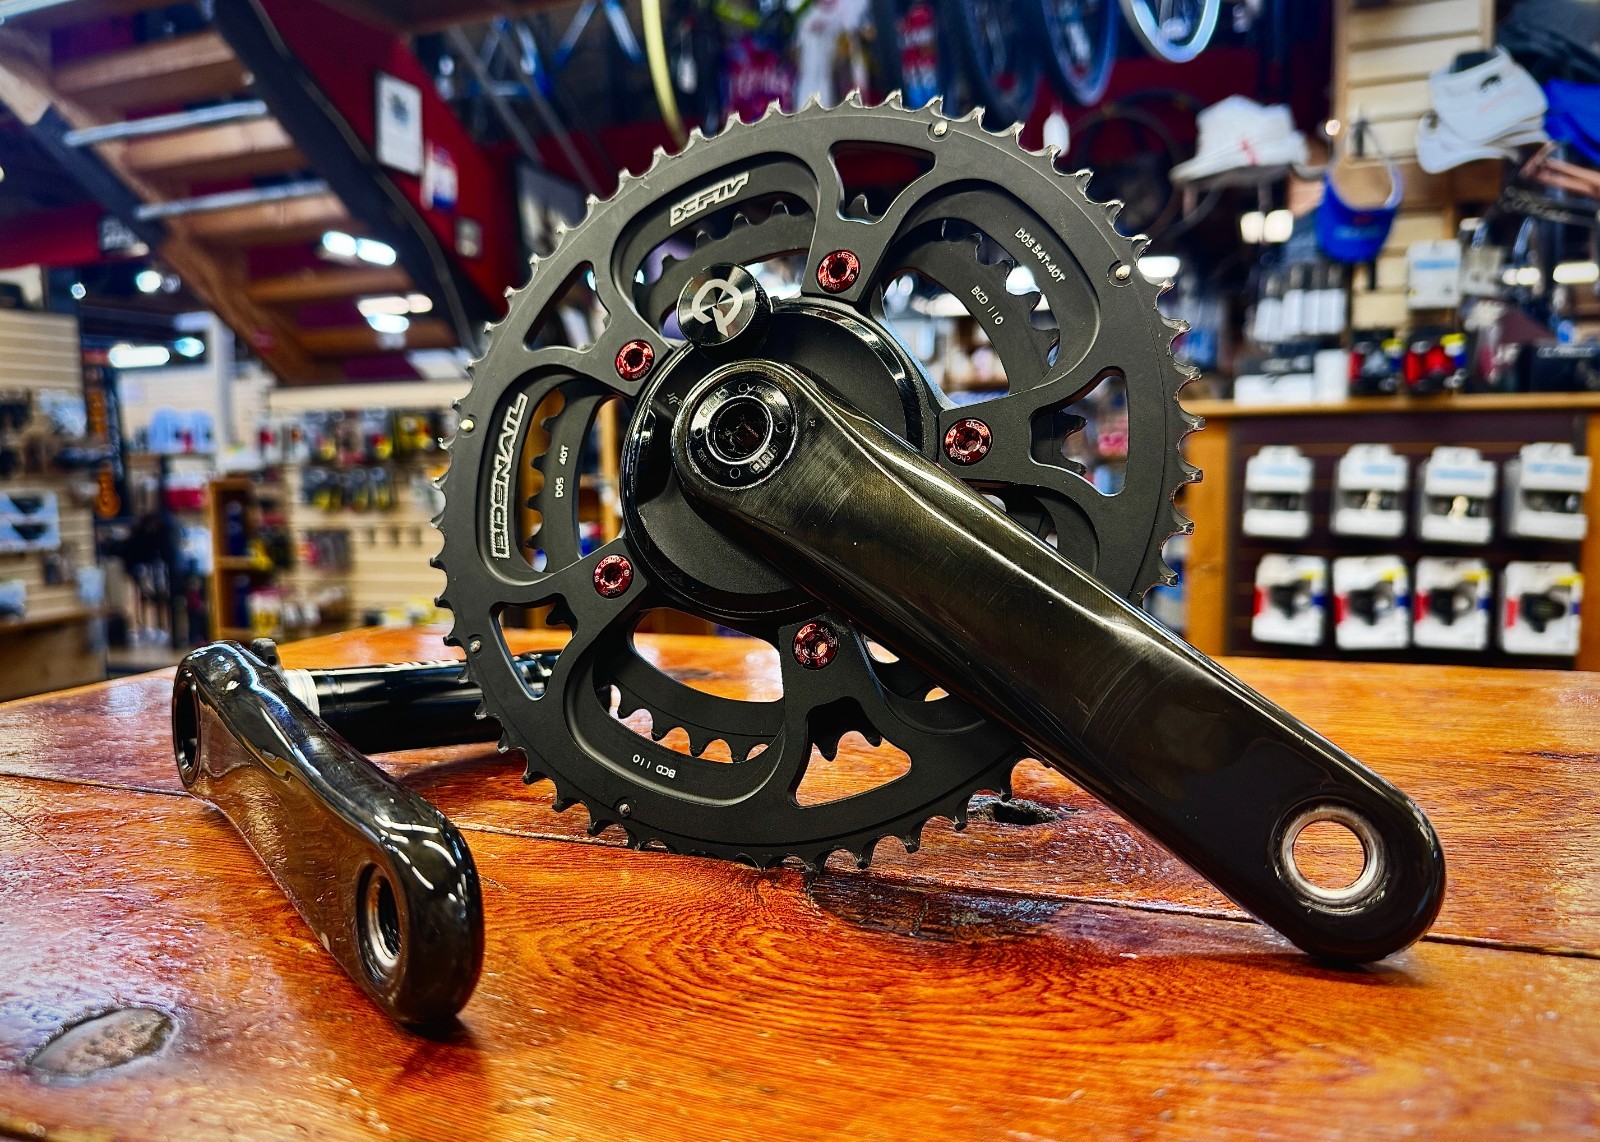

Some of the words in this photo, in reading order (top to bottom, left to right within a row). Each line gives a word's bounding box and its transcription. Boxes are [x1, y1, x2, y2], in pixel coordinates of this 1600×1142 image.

[1014, 227, 1036, 248] DOS
[1031, 243, 1067, 283] 54T-40T
[970, 285, 989, 305] BCD
[987, 305, 1004, 325] 110
[558, 444, 569, 466] 40T
[554, 476, 565, 498] DOS
[632, 754, 651, 769] 110
[655, 764, 677, 779] BCD
